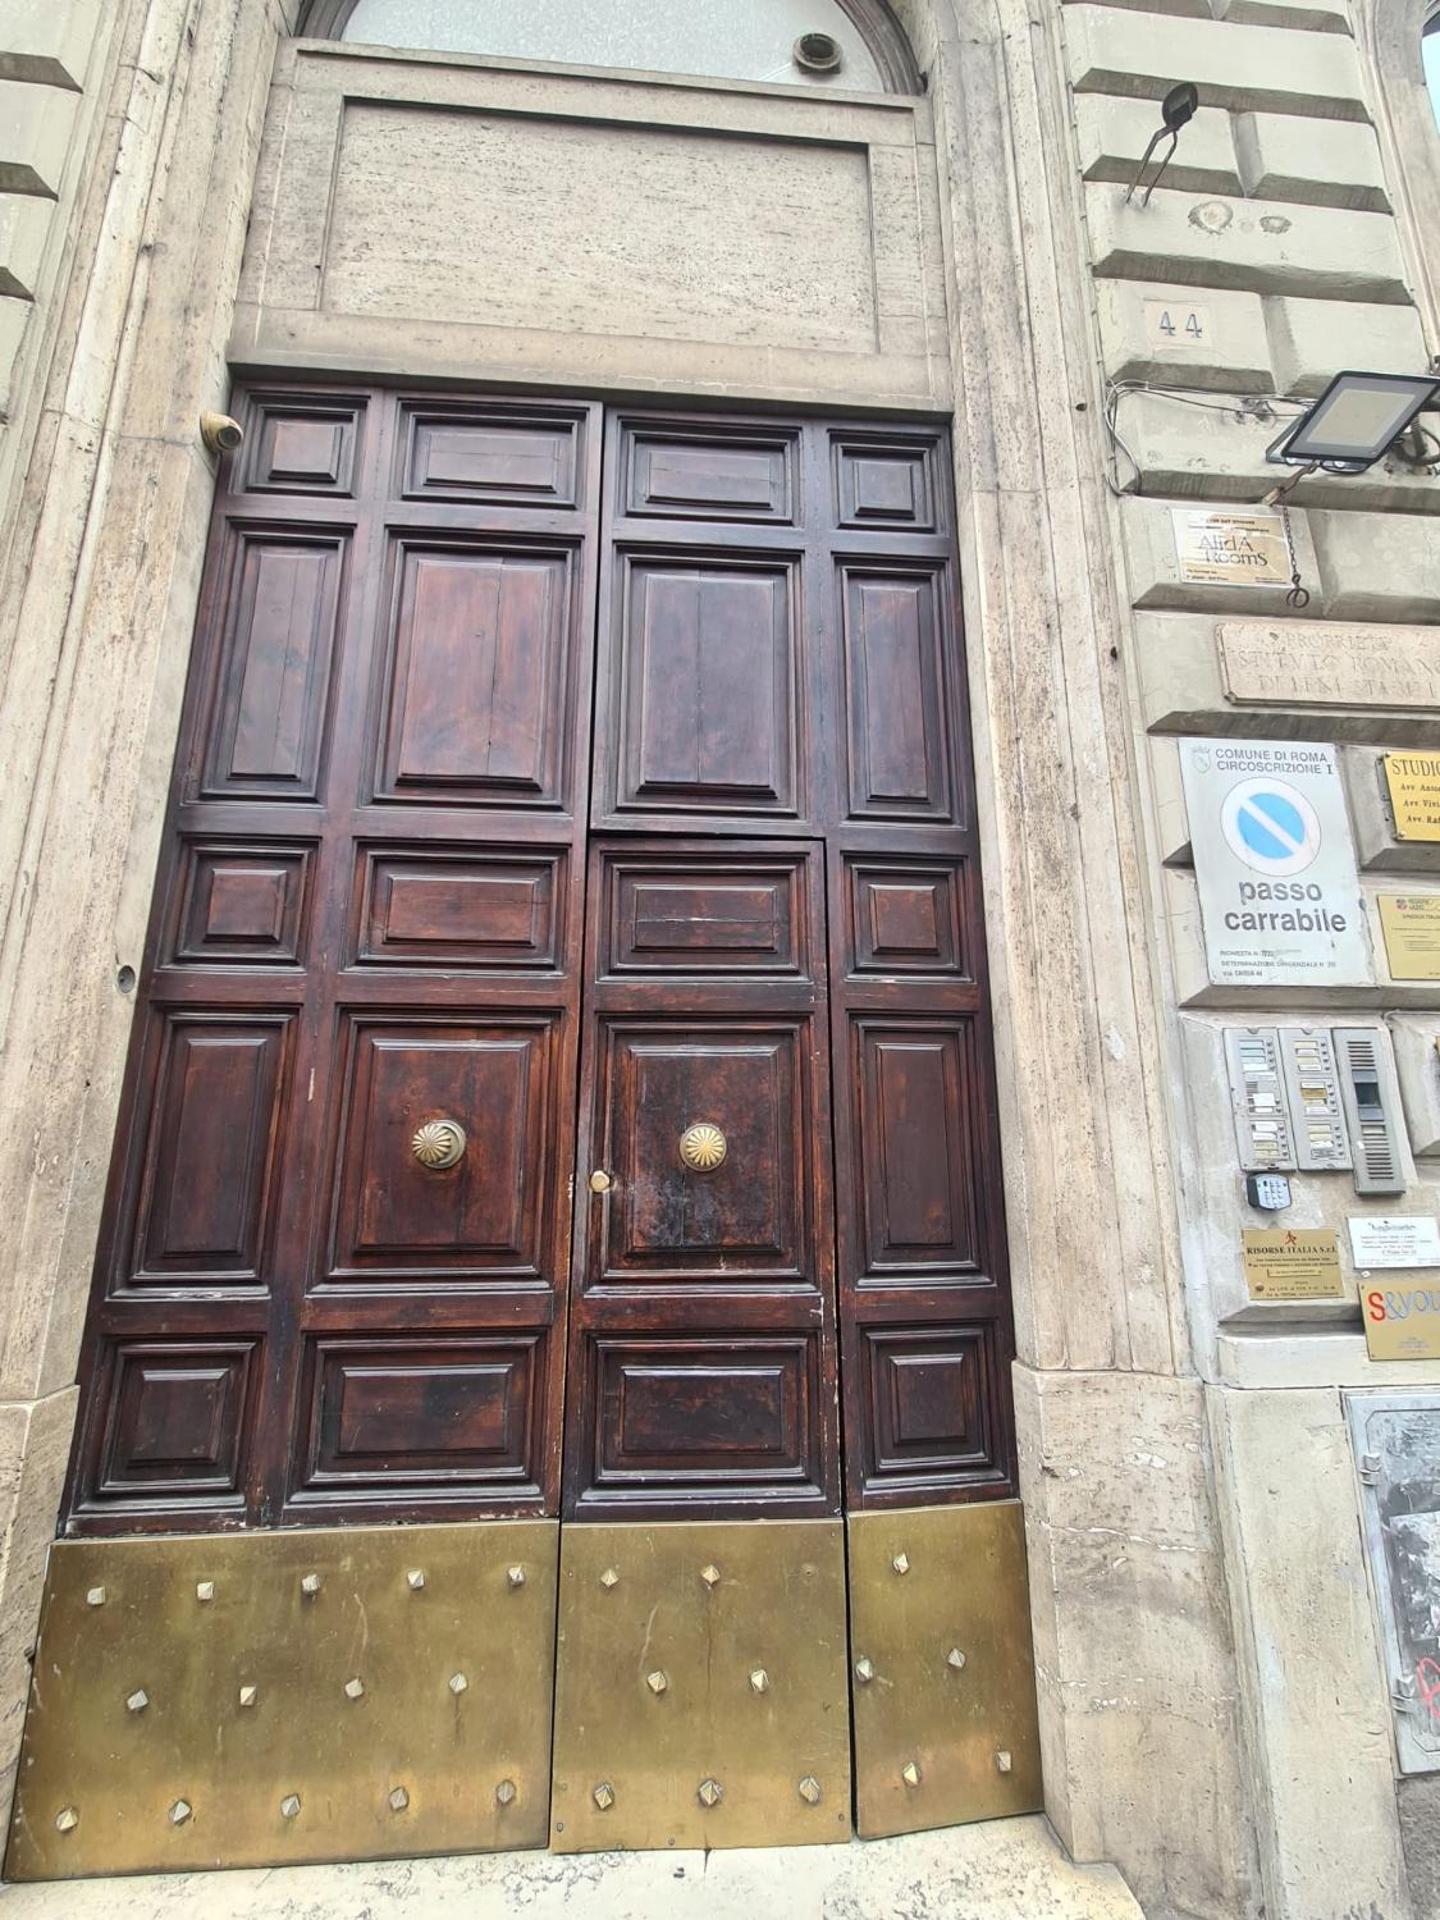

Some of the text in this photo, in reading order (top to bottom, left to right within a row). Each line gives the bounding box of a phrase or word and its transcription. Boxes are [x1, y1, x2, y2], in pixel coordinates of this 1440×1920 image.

[1215, 748, 1328, 762] COMUNE DI ROMA
[1216, 760, 1322, 774] CIRCOSCRIZIONE
[1238, 880, 1322, 906] passo
[1224, 907, 1347, 933] carrabile
[1247, 1246, 1284, 1255] RISORSE
[1288, 1246, 1318, 1254] ITALIA
